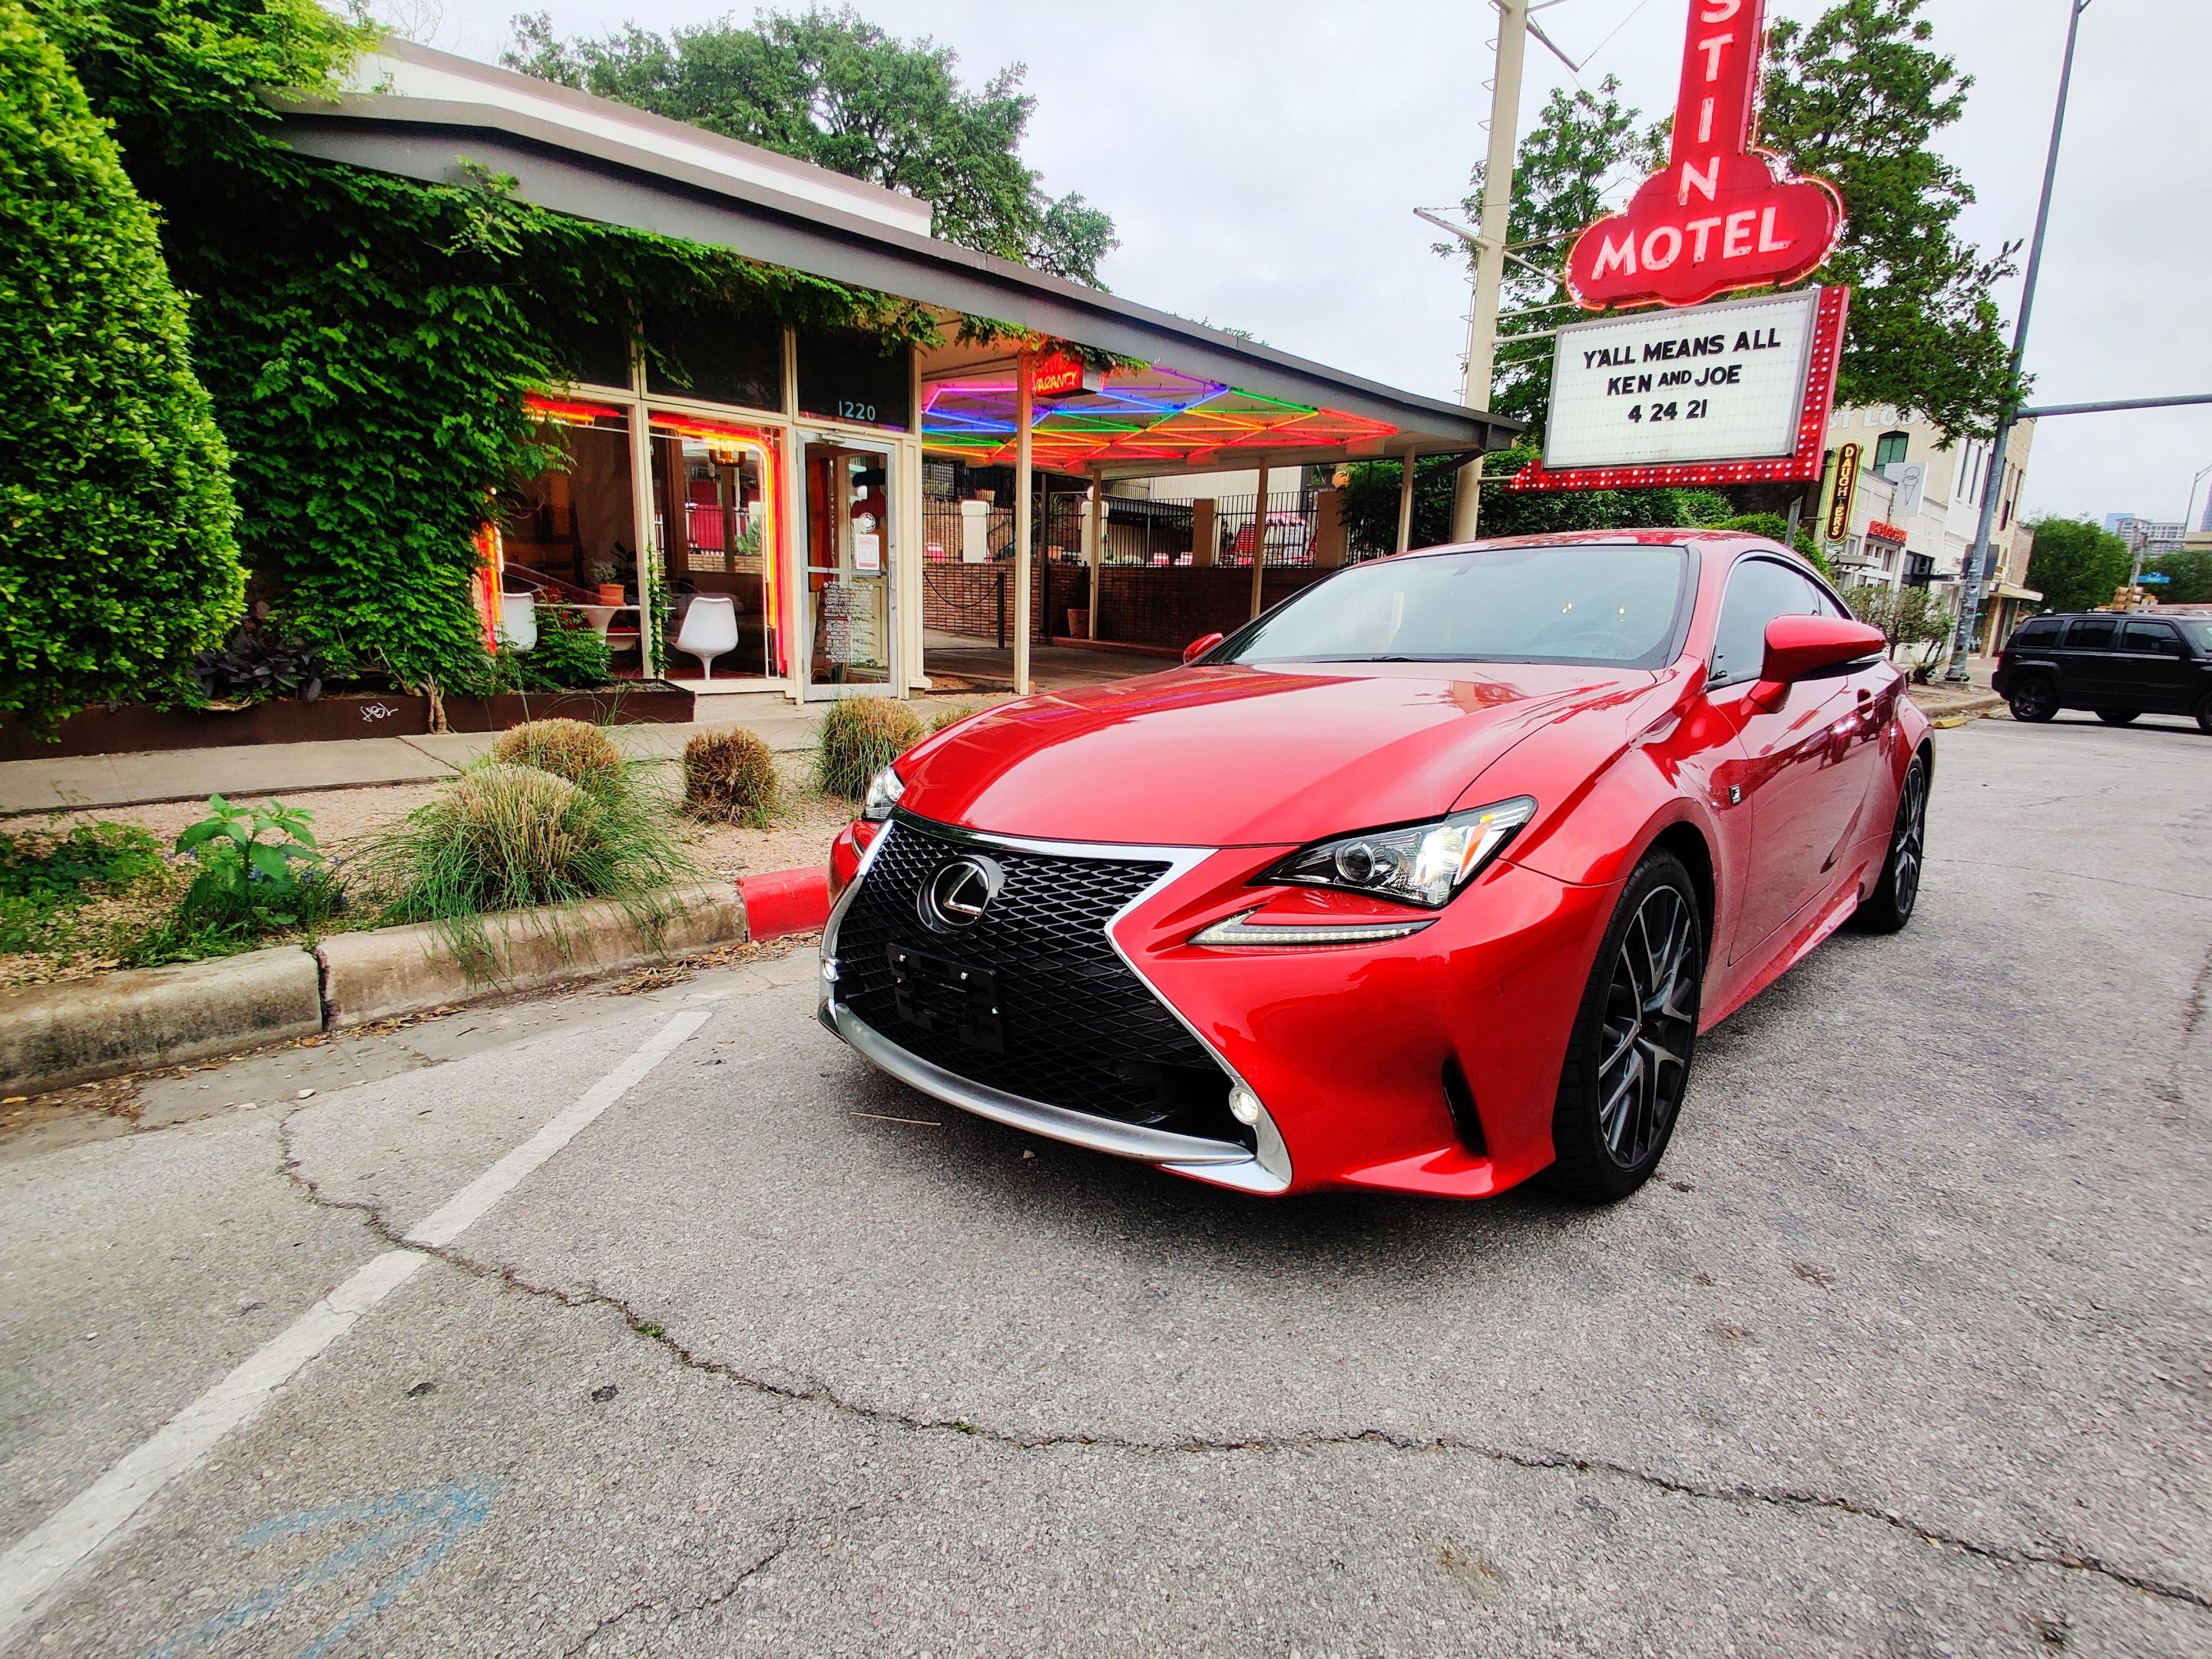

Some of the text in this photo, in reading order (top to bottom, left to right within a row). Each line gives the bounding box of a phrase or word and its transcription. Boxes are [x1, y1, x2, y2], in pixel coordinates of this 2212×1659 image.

[1591, 206, 1793, 281] MOTEL
[1584, 328, 1781, 369] Y'ALL MEANS ALL
[1607, 364, 1743, 396] KEN AND JOE
[839, 400, 876, 421] 1220
[1628, 399, 1708, 423] 4 24 21
[1831, 445, 1855, 536] DAUGHTERS
